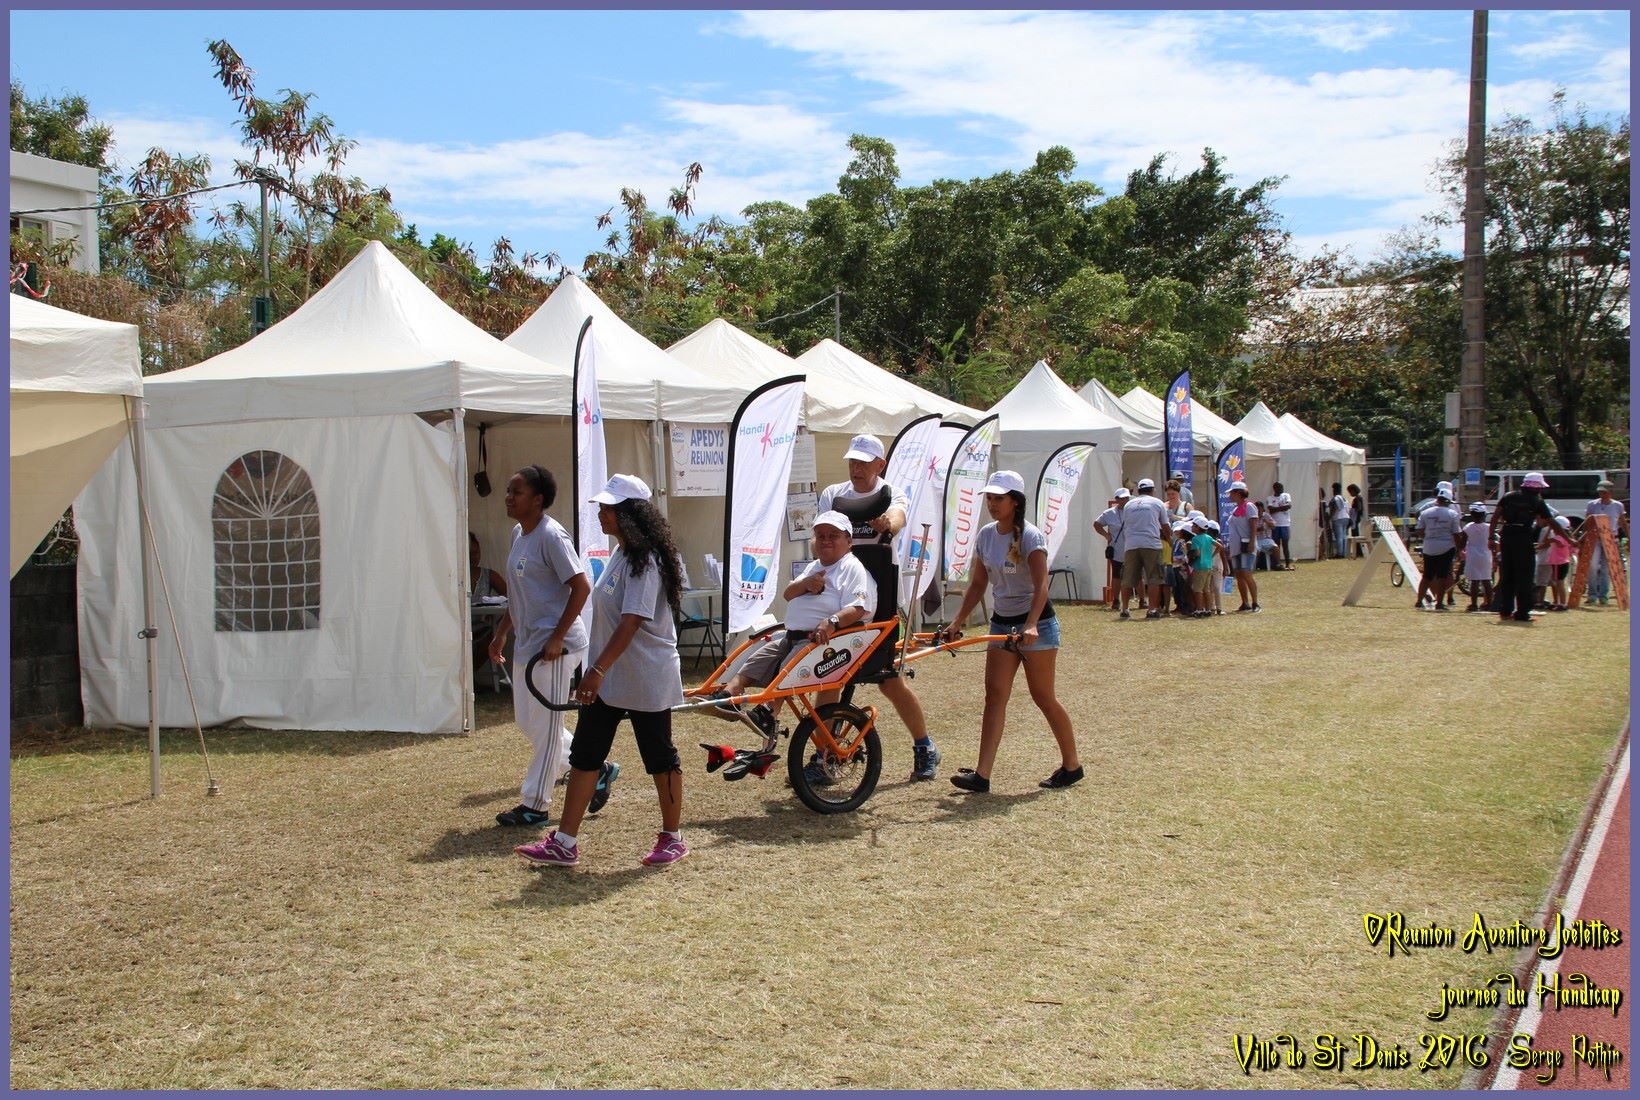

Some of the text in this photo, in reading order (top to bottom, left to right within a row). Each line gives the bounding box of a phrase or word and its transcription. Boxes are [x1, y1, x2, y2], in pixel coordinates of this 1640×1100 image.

[690, 429, 724, 447] APEDYS
[691, 450, 724, 465] REUNION
[951, 487, 974, 577] ACCUEIL
